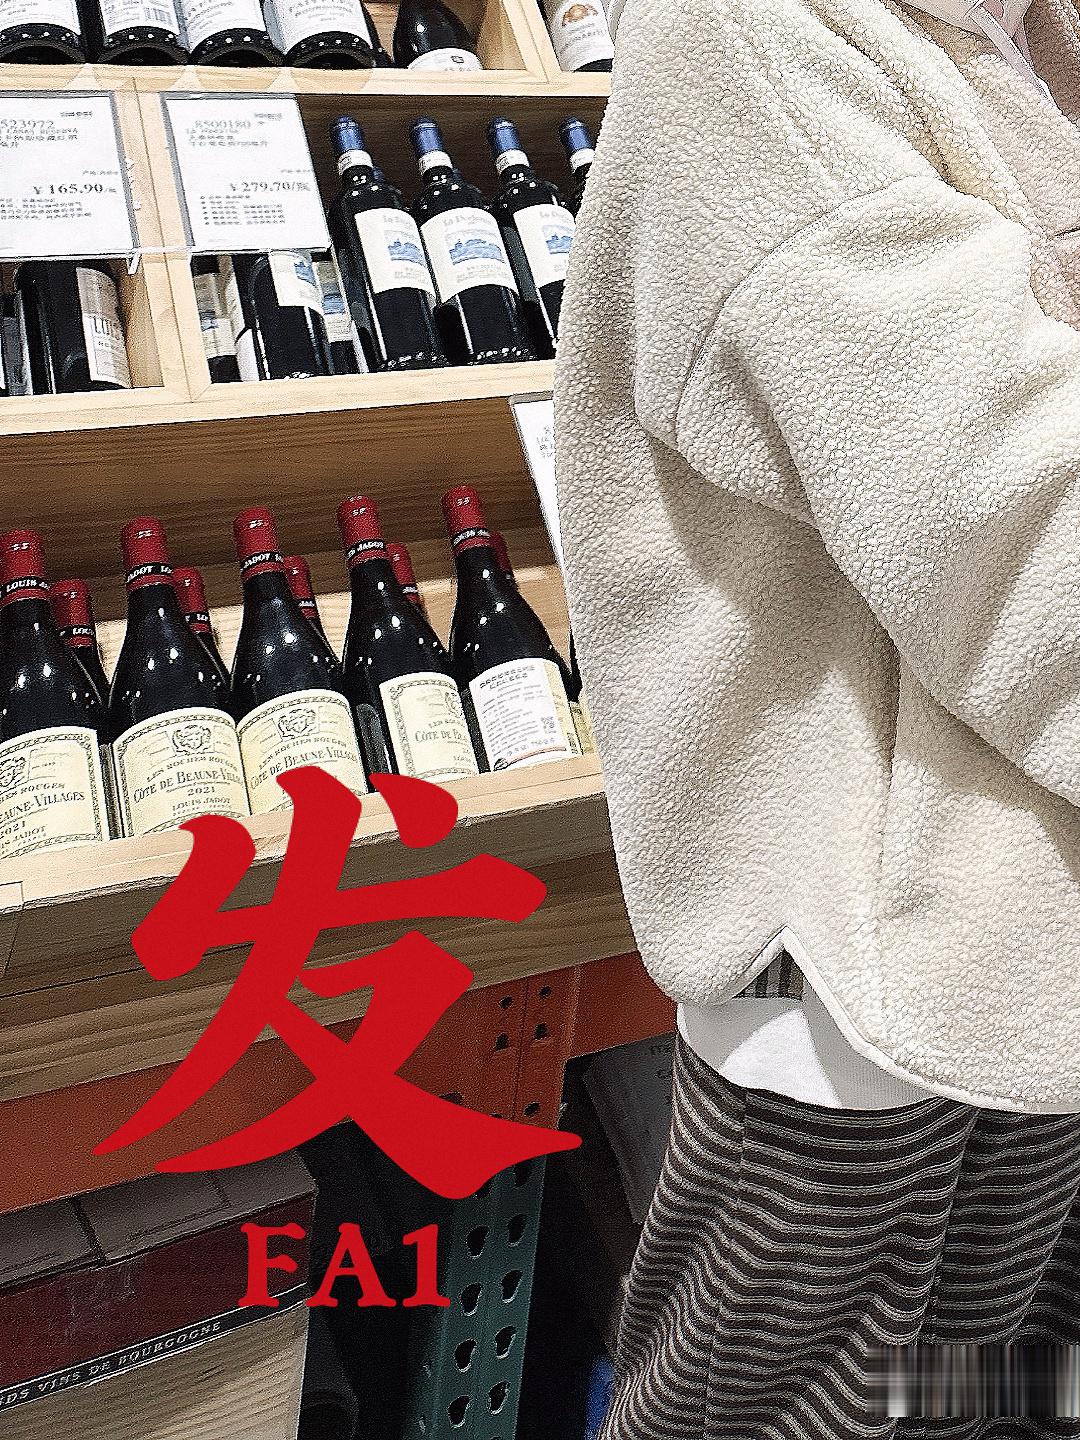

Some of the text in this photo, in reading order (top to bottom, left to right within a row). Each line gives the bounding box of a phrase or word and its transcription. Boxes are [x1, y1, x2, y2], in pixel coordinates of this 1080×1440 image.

[186, 786, 216, 797] 2021
[88, 1359, 111, 1377] DE
[117, 1320, 222, 1367] BOURGOGNE
